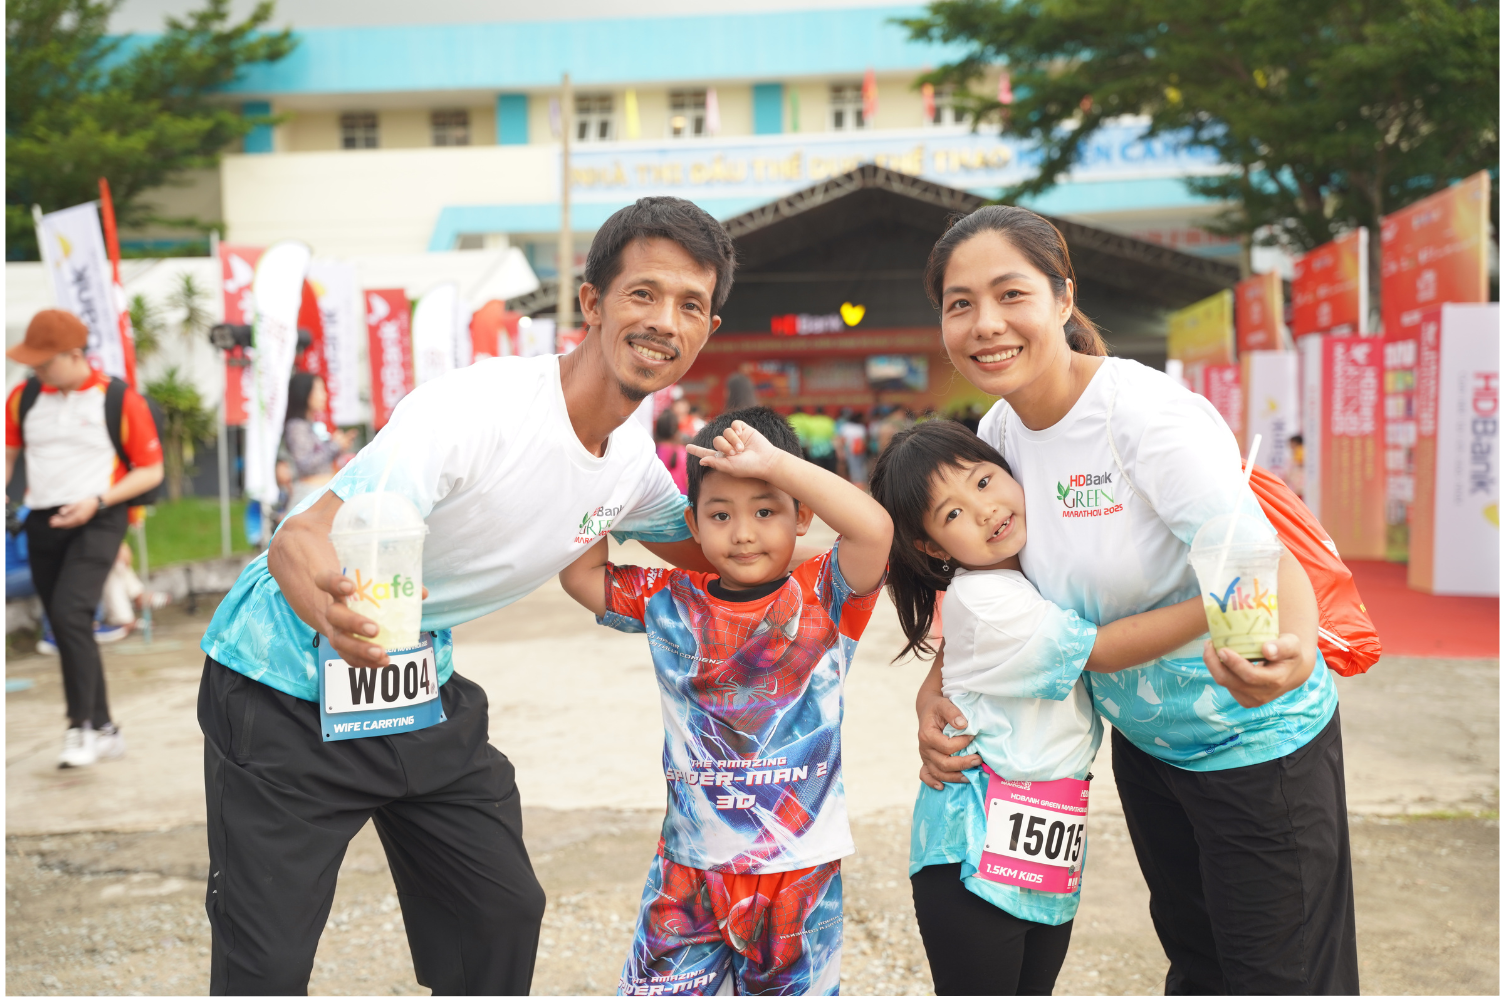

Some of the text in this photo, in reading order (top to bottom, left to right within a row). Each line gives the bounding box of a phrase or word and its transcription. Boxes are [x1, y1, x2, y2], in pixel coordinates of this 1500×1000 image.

[1070, 471, 1113, 487] HDBank
[1063, 488, 1114, 508] GREEN
[1062, 504, 1123, 518] MARATHON 2025
[348, 657, 430, 706] W004
[333, 715, 415, 733] WIFE CARRYING
[690, 756, 787, 769] THE AMAZING
[666, 761, 829, 787] SPIDER-MAN 2
[715, 795, 756, 810] 3D
[1010, 793, 1040, 805] HDBANK
[1040, 799, 1061, 810] GREEN
[1009, 812, 1085, 862] 15015
[986, 864, 1018, 879] 1.5KM
[651, 968, 706, 983] AMAZING
